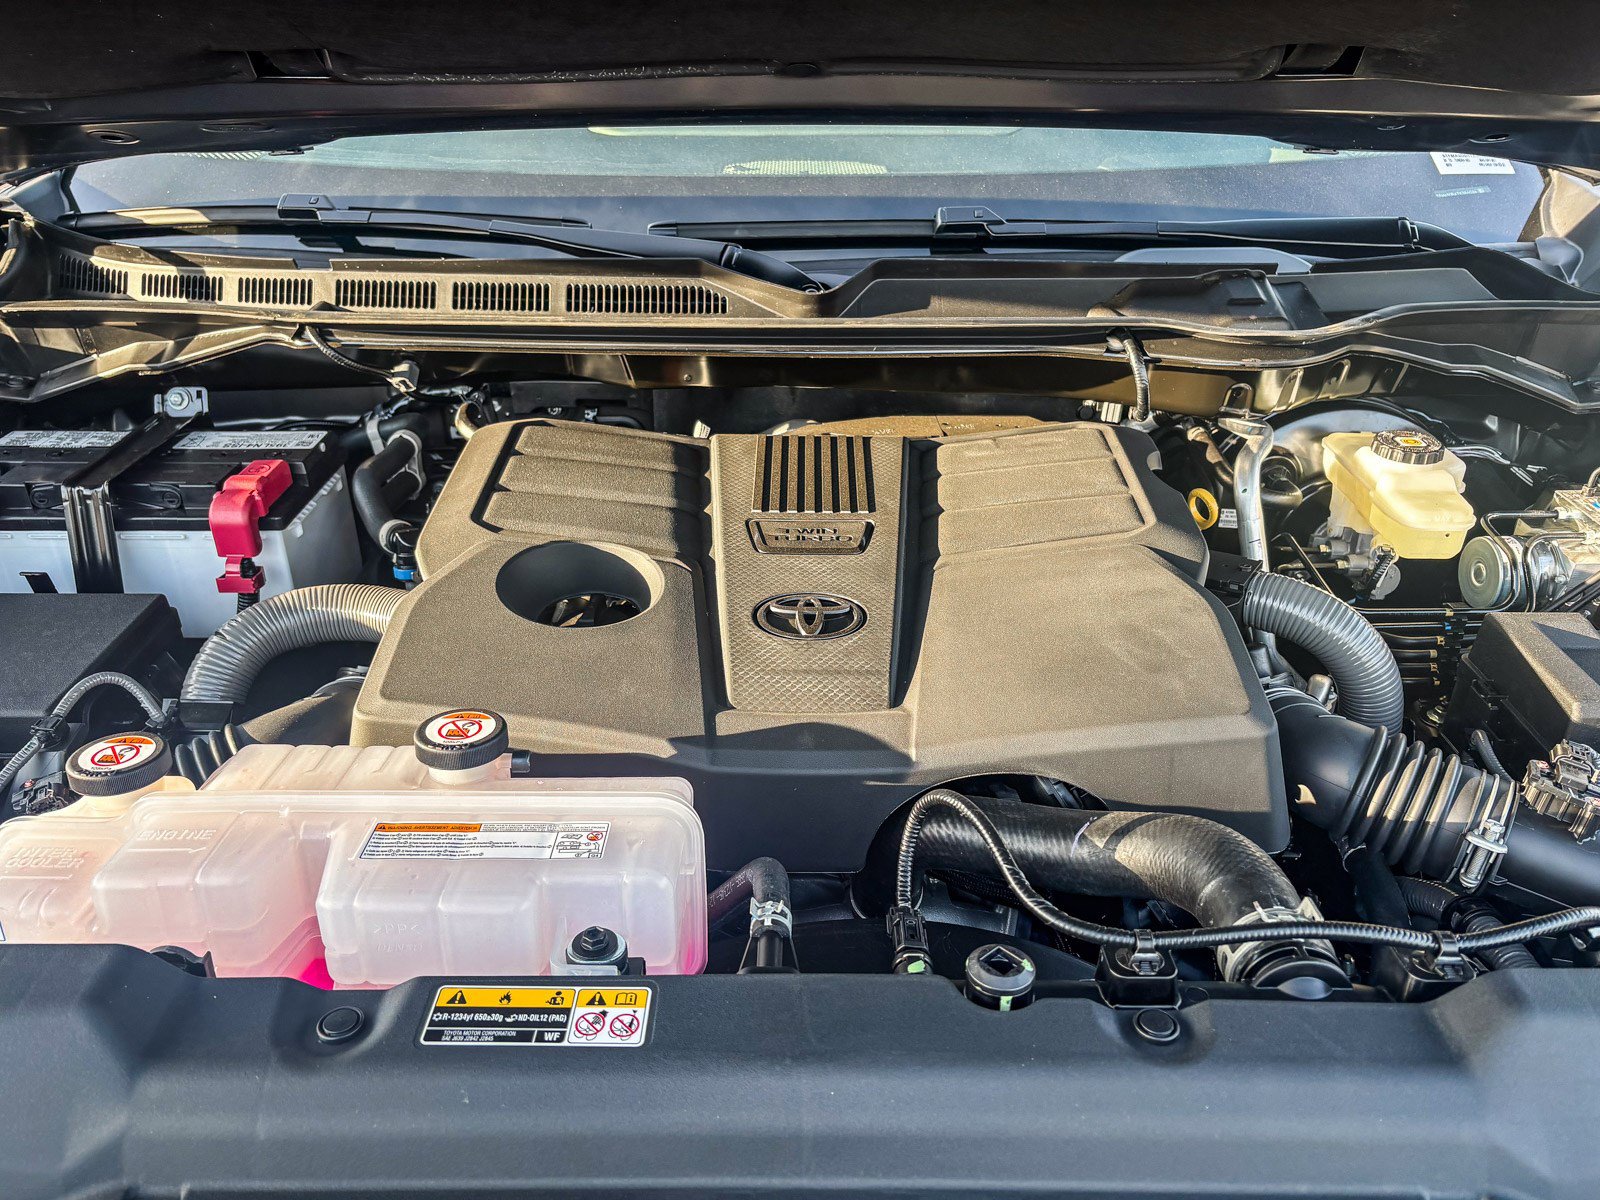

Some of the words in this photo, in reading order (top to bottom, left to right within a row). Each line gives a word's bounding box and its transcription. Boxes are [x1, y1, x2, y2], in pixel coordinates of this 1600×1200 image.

[768, 533, 853, 541] TURBO
[14, 847, 78, 857] INTER
[442, 1012, 474, 1022] R-1234yf
[548, 1014, 567, 1023] (PAG)
[543, 1032, 560, 1041] WF
